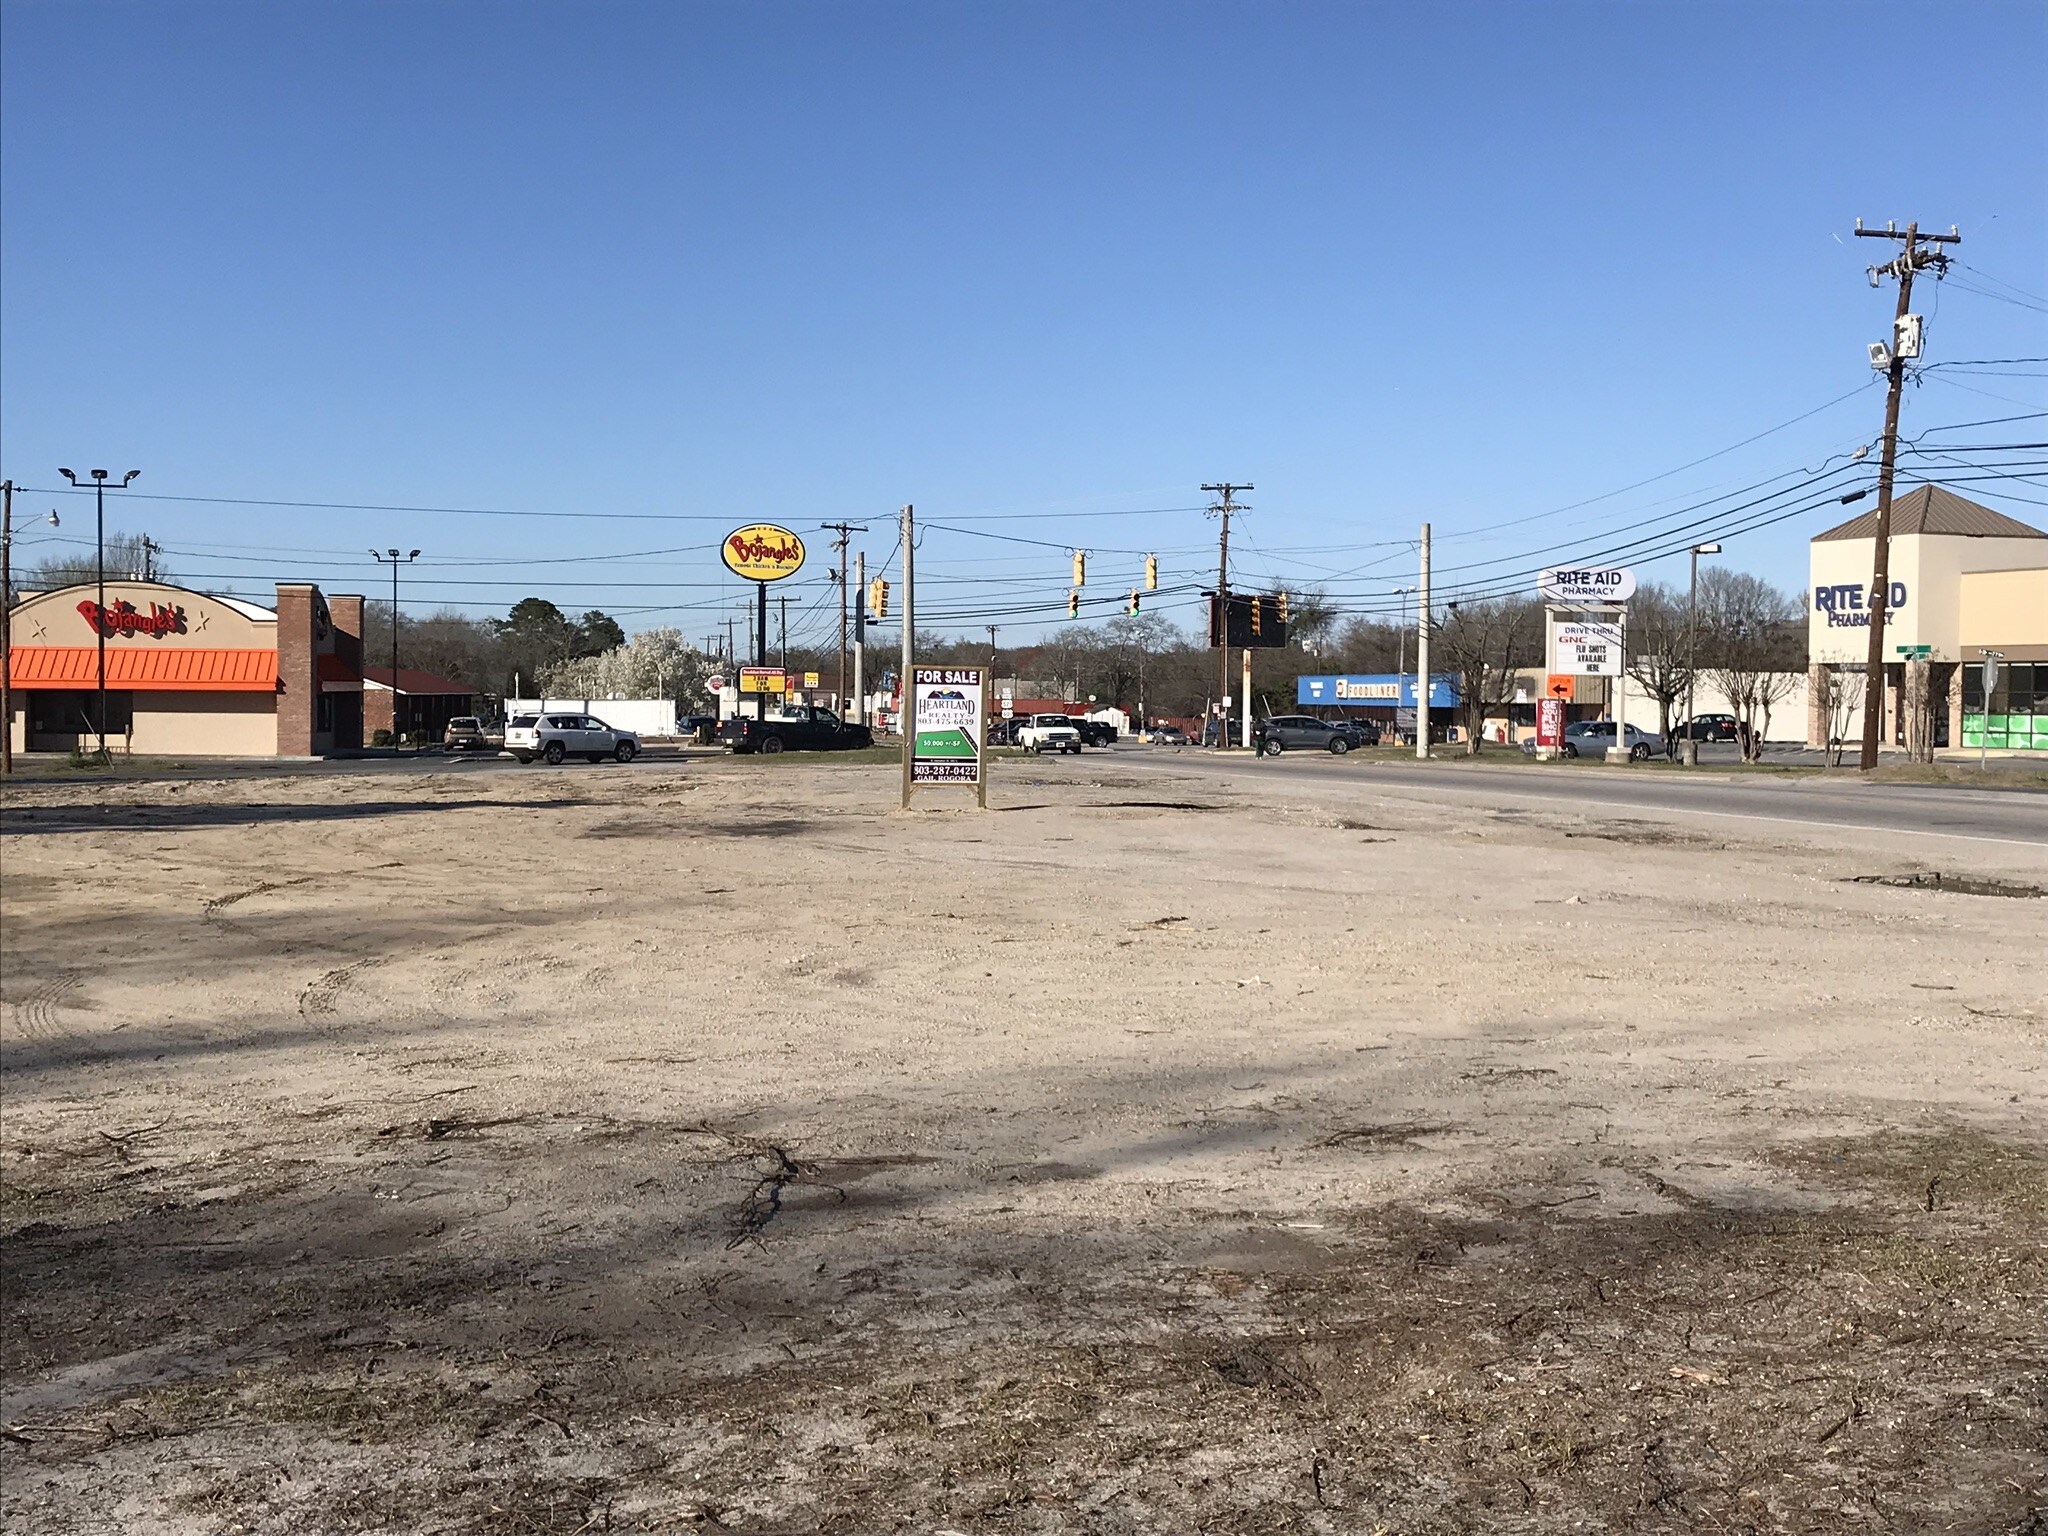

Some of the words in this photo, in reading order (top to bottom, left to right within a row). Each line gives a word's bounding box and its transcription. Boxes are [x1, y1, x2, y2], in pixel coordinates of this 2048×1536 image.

[1557, 571, 1590, 584] RITE
[1595, 572, 1621, 585] AID
[1562, 586, 1615, 595] PHARMACY
[1816, 584, 1863, 611] RITE
[1576, 645, 1586, 653] FLU
[1588, 645, 1606, 653] SHOTS
[1578, 654, 1606, 662] AVAILABLE
[1586, 664, 1600, 672] HERE
[917, 670, 941, 682] FOR
[945, 671, 977, 683] SALE
[1350, 686, 1396, 696] FOODLINER
[919, 699, 975, 715] HEARTLAND
[1542, 701, 1562, 709] GE
[914, 766, 976, 775] 803-287-0422
